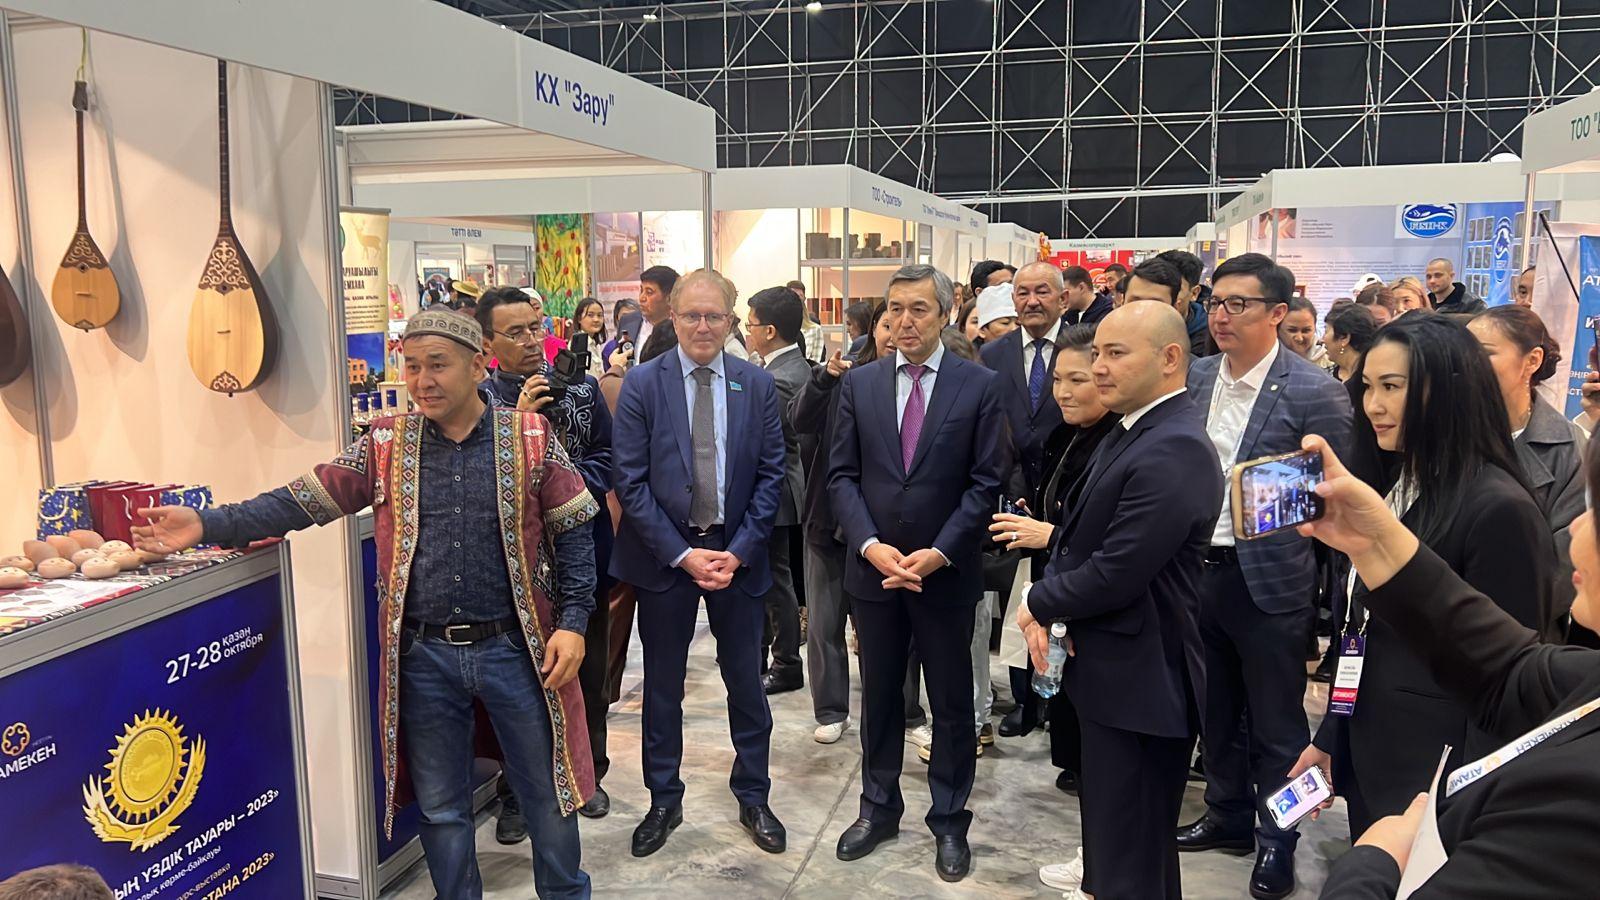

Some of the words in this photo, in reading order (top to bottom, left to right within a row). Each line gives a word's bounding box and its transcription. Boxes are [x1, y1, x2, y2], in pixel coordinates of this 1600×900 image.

[535, 70, 560, 107] КХ
[564, 79, 615, 126] "Зару"
[1571, 114, 1591, 141] ТОО
[165, 641, 222, 684] 27-28
[223, 633, 264, 658] октября
[185, 814, 236, 854] ТАУАРЫ
[246, 789, 280, 817] 2023»
[241, 851, 275, 882] 2023»
